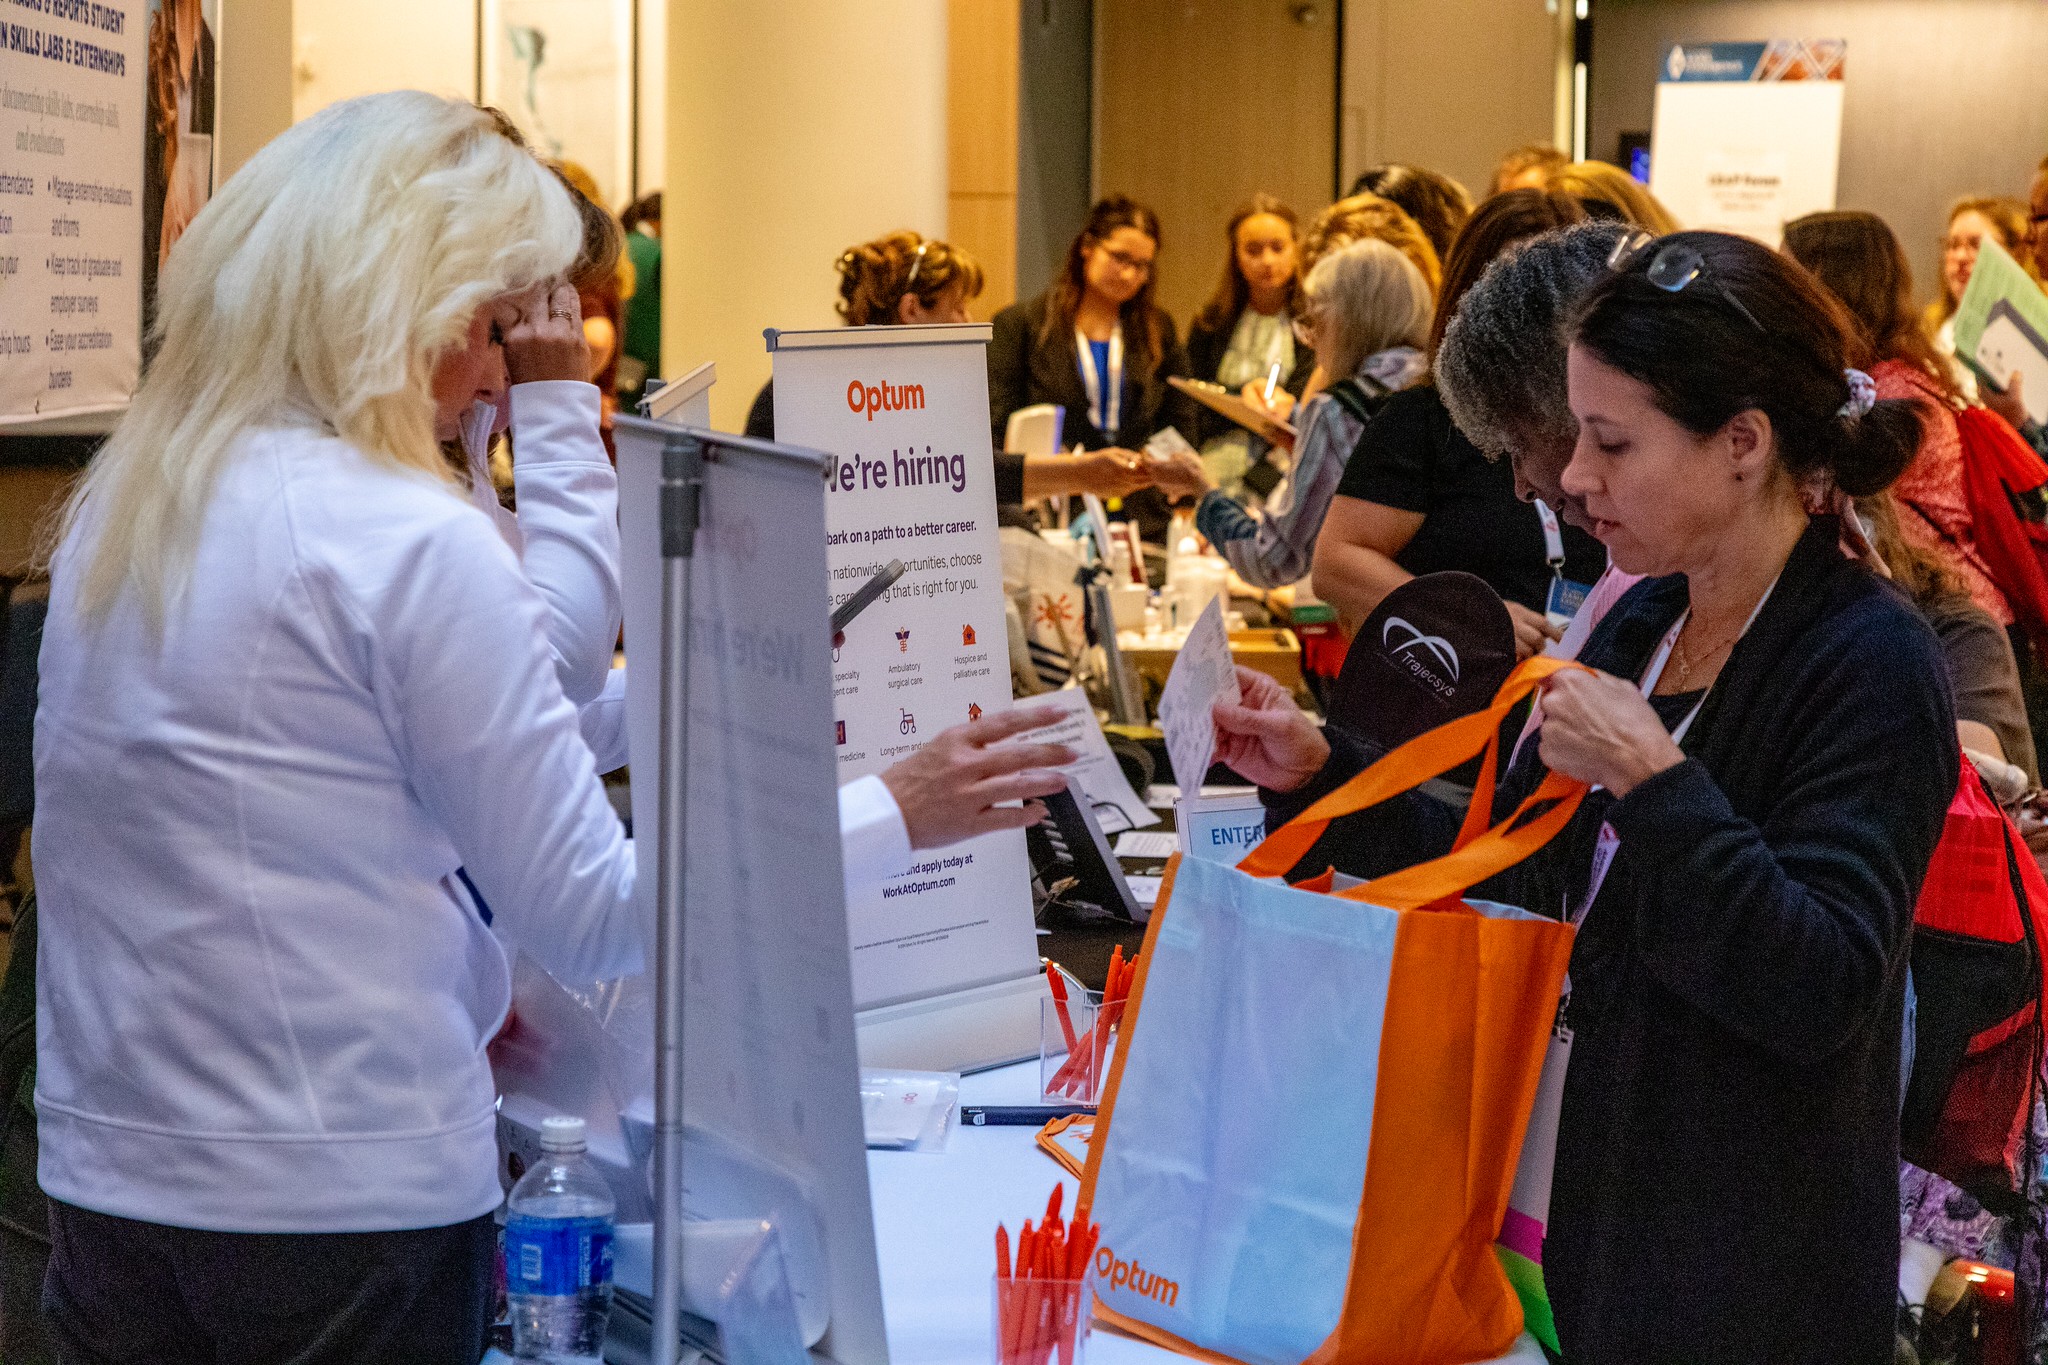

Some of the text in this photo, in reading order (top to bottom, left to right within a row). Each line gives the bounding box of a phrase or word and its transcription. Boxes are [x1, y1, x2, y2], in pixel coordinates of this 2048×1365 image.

[53, 0, 88, 25] REPORTS
[91, 4, 124, 35] STUDENT
[11, 23, 40, 56] SKILLS
[43, 32, 63, 62] LABS
[66, 38, 71, 64] &
[74, 40, 125, 76] EXTERNSHIPS
[52, 213, 62, 237] and
[51, 252, 65, 280] Keep
[13, 330, 30, 354] hours
[847, 379, 925, 421] Optum
[893, 446, 967, 493] hiring
[826, 520, 977, 545] bark on a path to a better career.
[903, 555, 949, 572] ortunities,
[950, 553, 982, 567] choose
[892, 584, 912, 599] that
[913, 582, 920, 596] is
[922, 579, 943, 598] right
[945, 577, 958, 592] for
[960, 578, 979, 595] you.
[888, 662, 921, 674] Ambulatory
[954, 652, 987, 665] Hospice and
[835, 670, 860, 682] specialty
[888, 676, 923, 689] surgical care
[954, 667, 990, 681] palliative care
[1402, 651, 1456, 697] Trajecsys
[846, 685, 858, 695] care
[840, 751, 866, 762] medicine
[880, 744, 910, 757] Long-term
[911, 742, 921, 750] and
[921, 859, 942, 875] apply
[943, 855, 964, 868] today
[965, 853, 973, 864] at
[883, 876, 956, 899] WorkAtOptum.com
[1095, 1246, 1179, 1308] Optum
